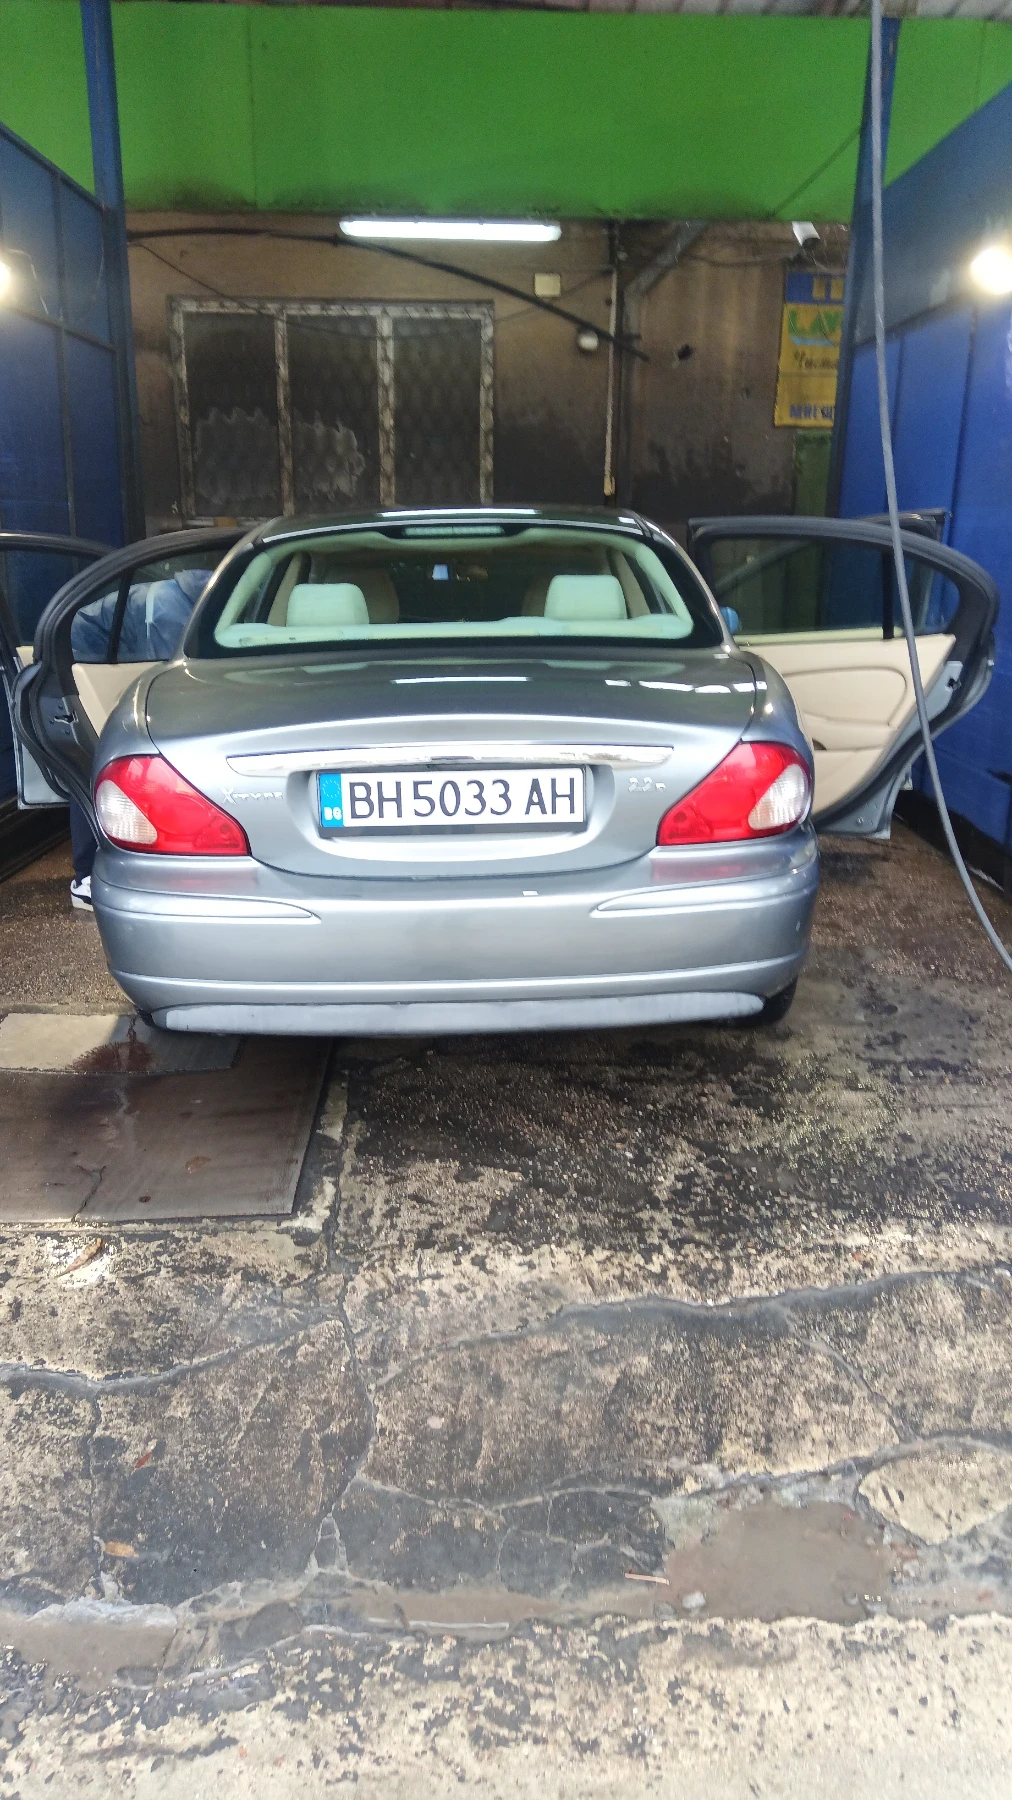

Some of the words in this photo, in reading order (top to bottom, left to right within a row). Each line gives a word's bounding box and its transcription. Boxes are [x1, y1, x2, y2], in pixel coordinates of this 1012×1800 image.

[348, 780, 403, 819] BH
[412, 777, 512, 818] 5033
[524, 777, 575, 815] AH
